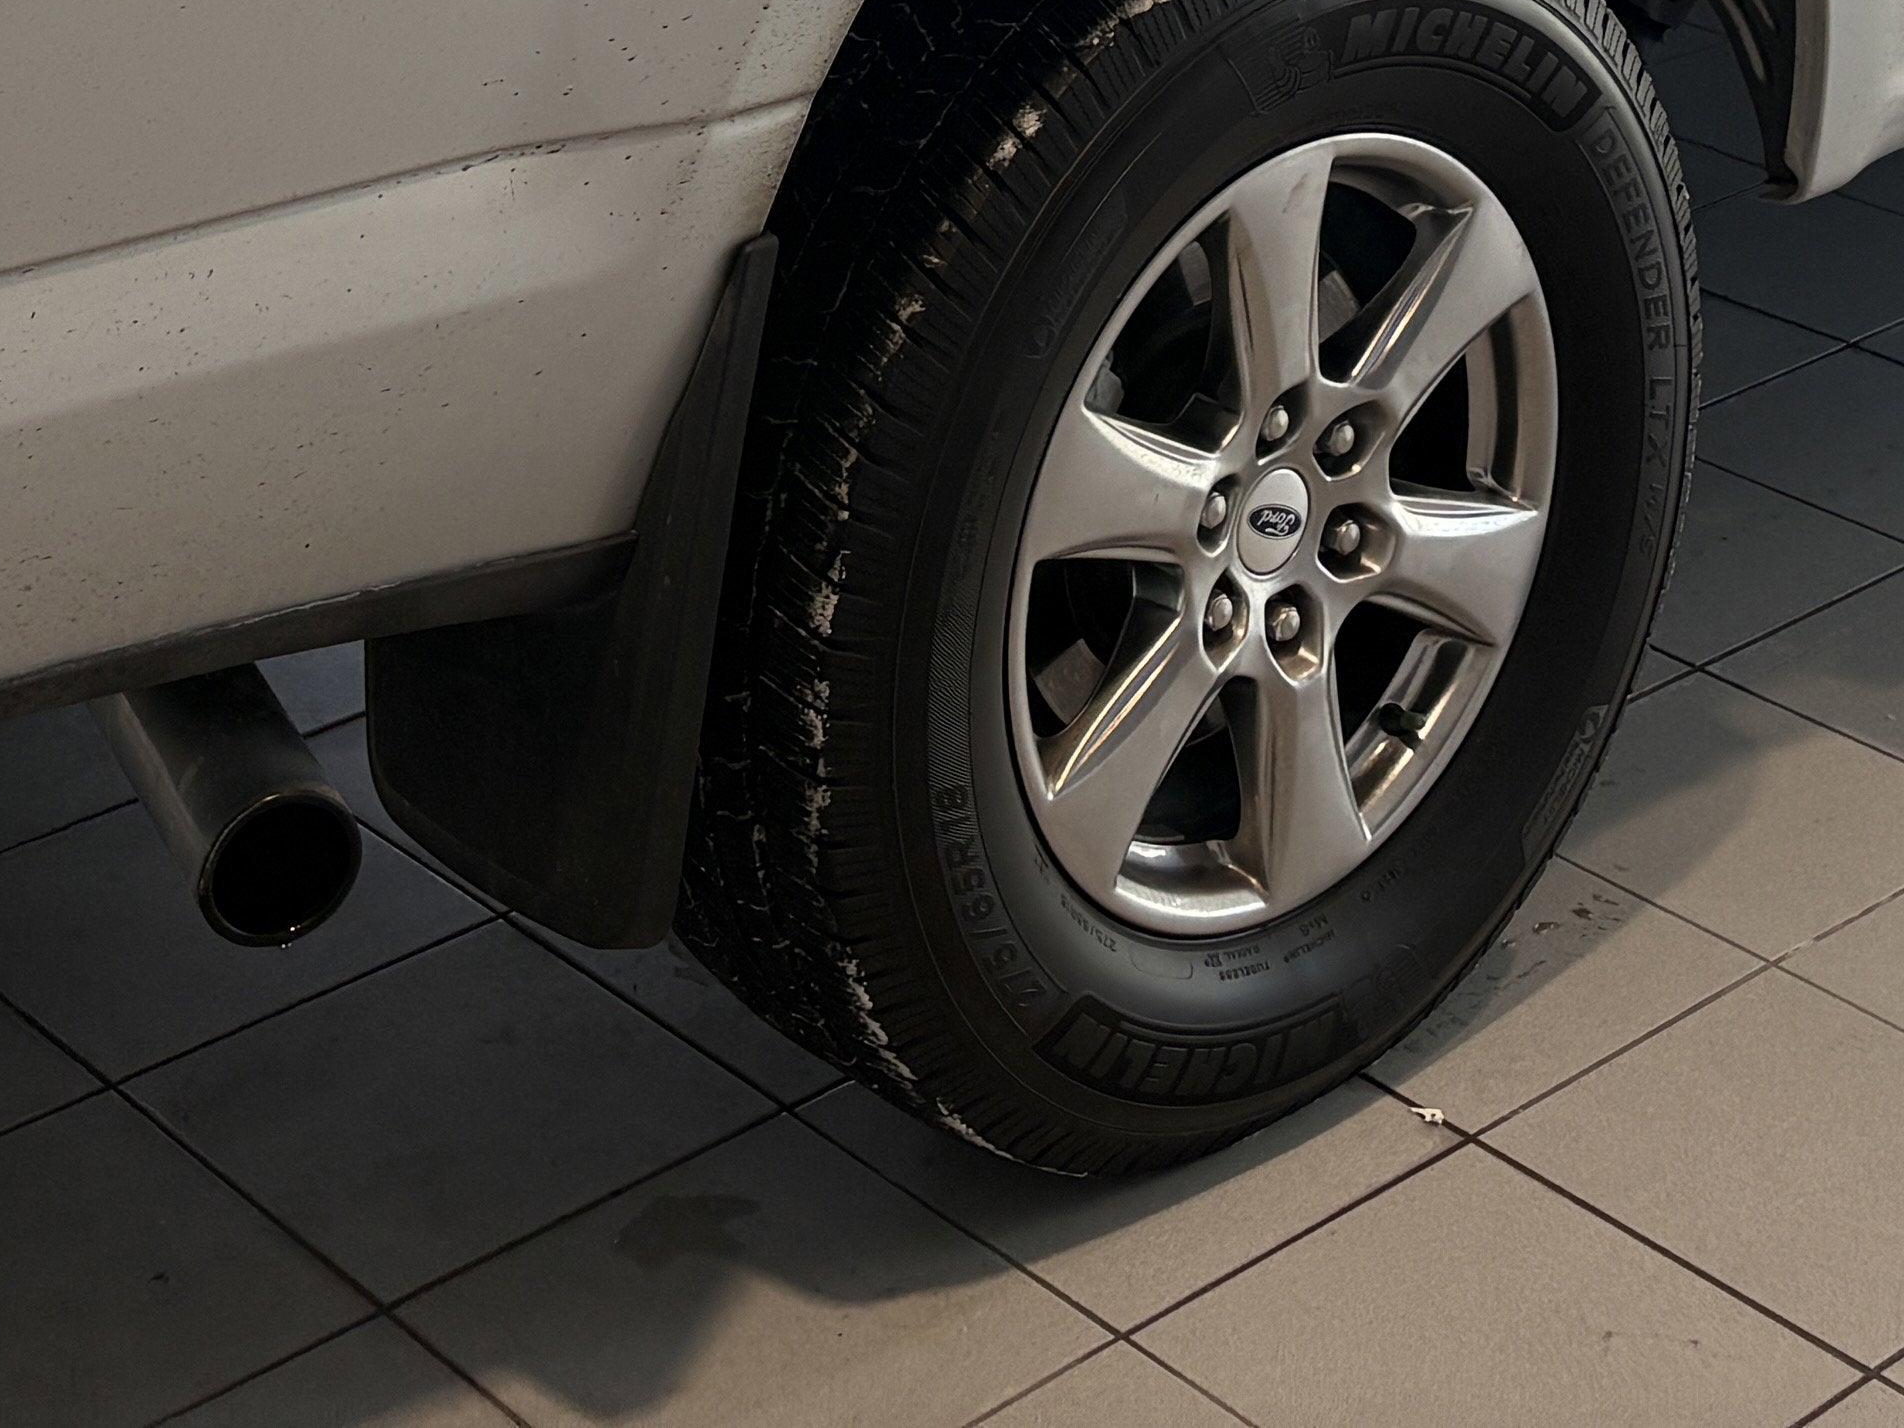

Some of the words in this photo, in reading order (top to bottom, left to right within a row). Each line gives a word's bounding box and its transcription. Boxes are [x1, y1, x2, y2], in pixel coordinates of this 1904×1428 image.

[1342, 7, 1591, 118] MICHELIN
[1590, 124, 1672, 350] DEFENDER
[1645, 375, 1674, 468] LTX
[1258, 506, 1297, 535] Ford
[1059, 1007, 1347, 1100] MICHELIN
